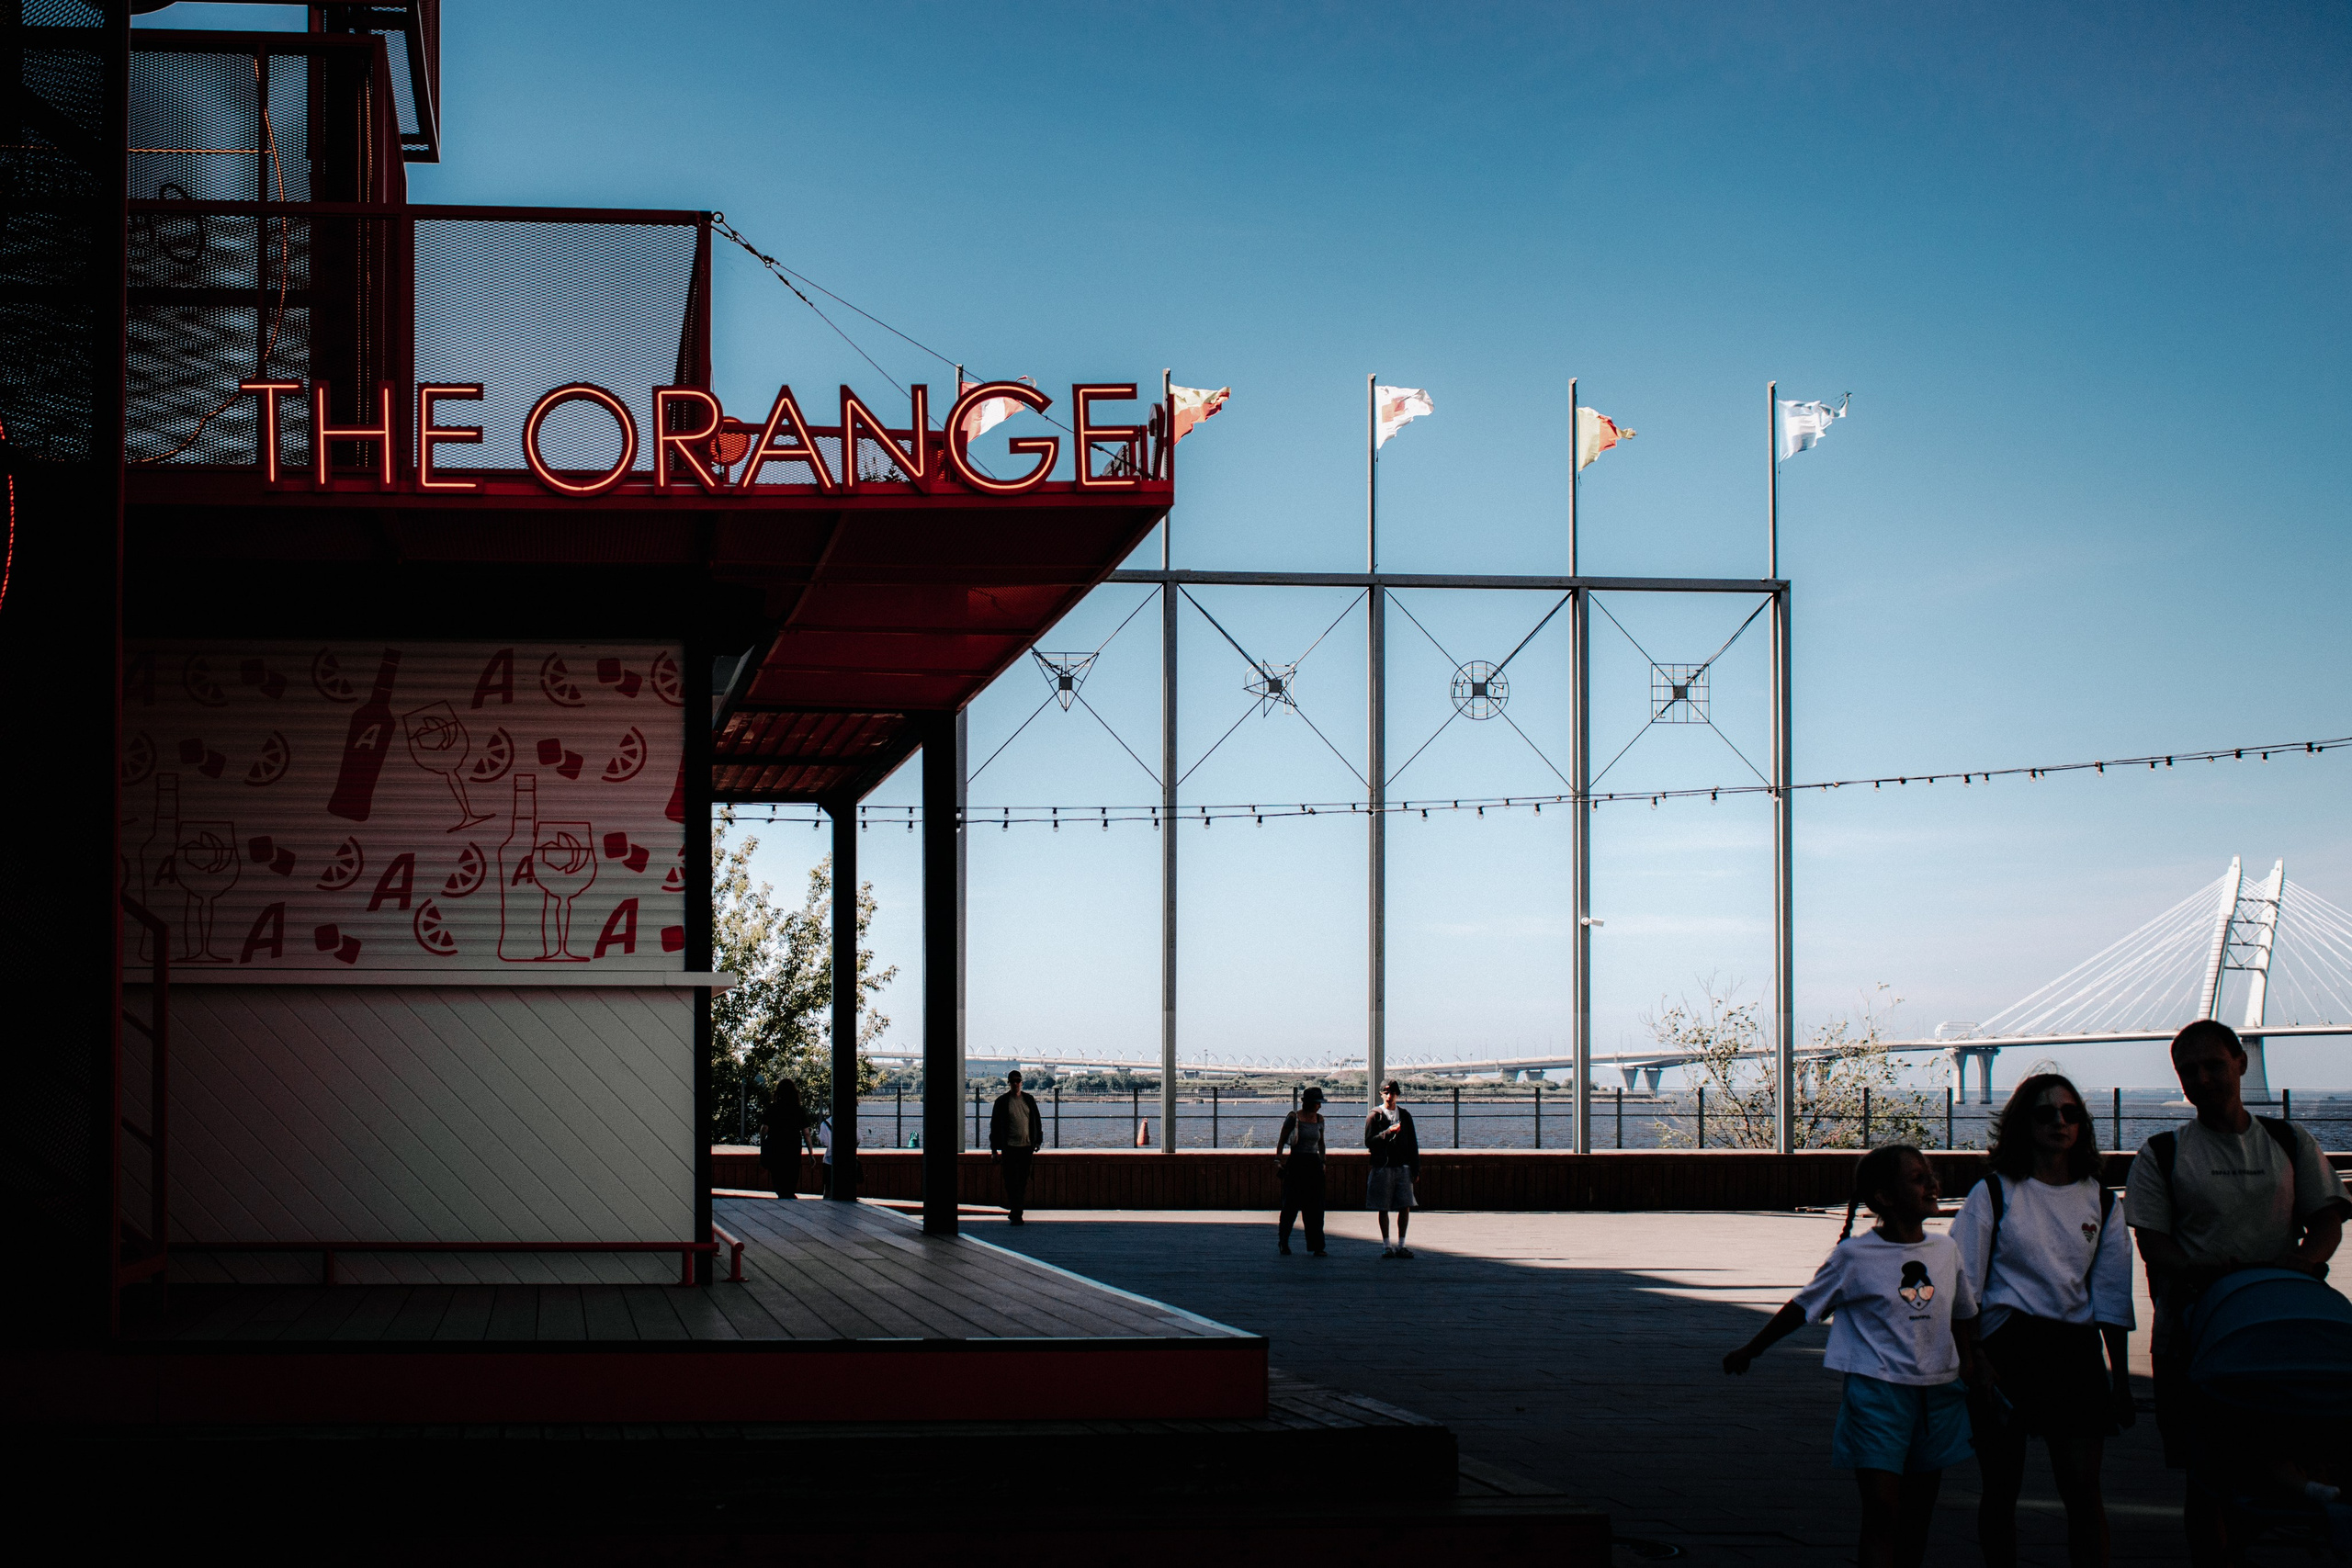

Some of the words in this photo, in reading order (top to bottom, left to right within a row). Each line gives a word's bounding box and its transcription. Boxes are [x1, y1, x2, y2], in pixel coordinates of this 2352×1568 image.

[241, 379, 484, 493] THE
[522, 381, 1140, 496] ORANGE
[471, 648, 514, 709] A
[354, 723, 382, 750] A
[153, 855, 175, 886] A
[368, 853, 415, 911] A
[512, 855, 533, 886] A
[240, 901, 286, 964] A
[594, 897, 639, 959] A
